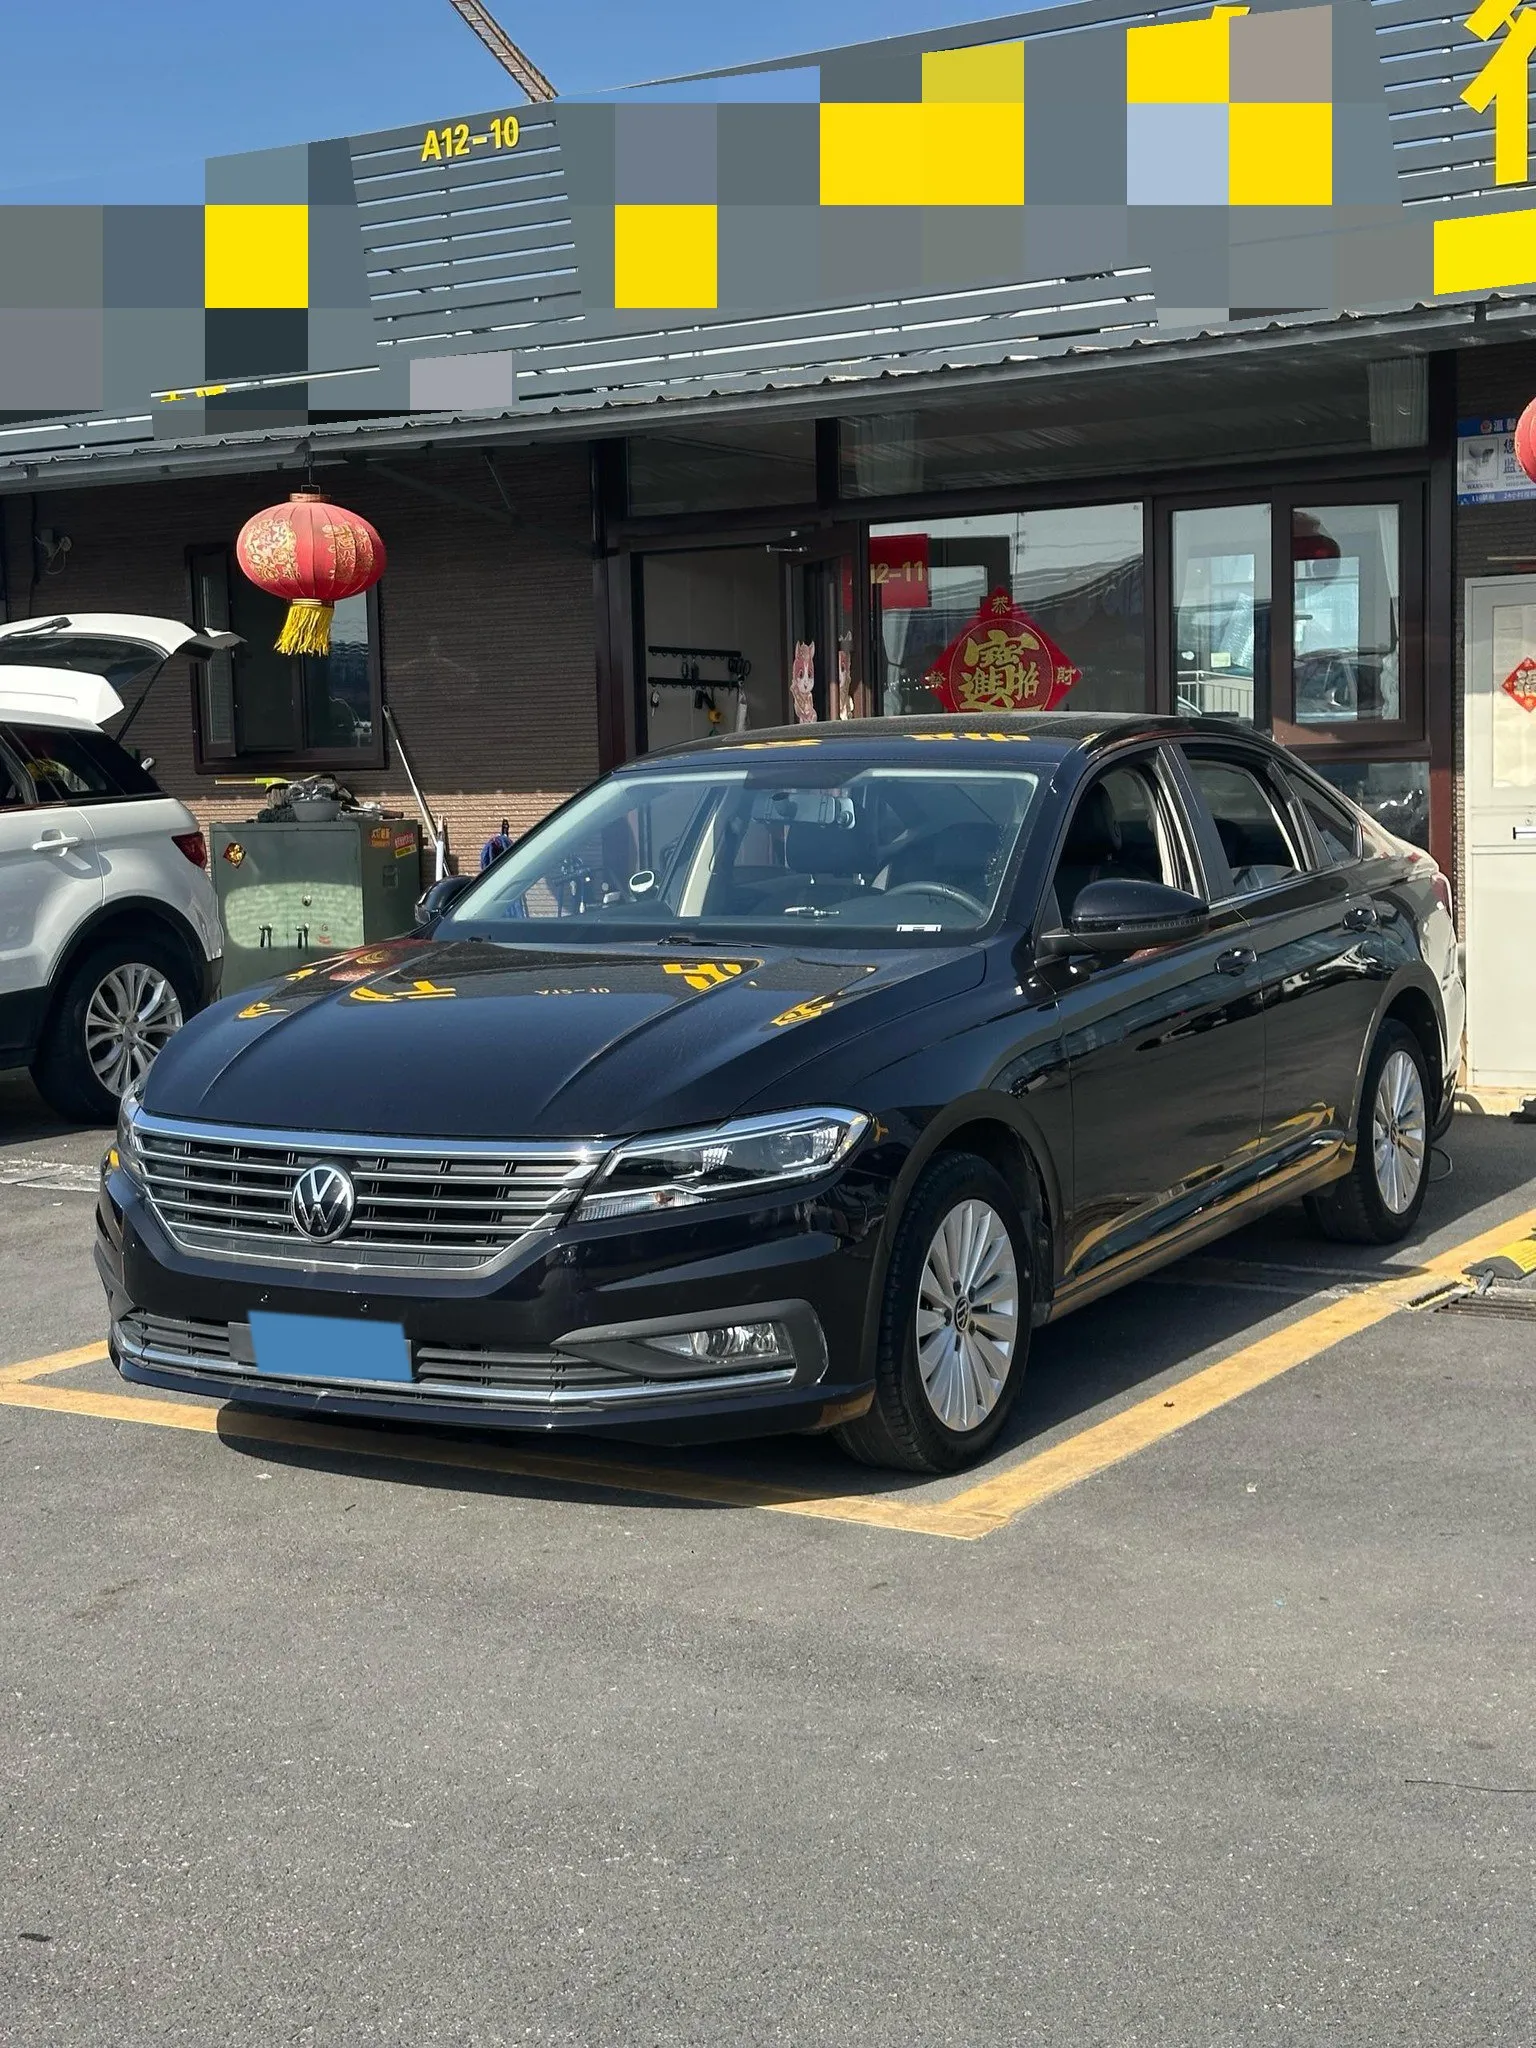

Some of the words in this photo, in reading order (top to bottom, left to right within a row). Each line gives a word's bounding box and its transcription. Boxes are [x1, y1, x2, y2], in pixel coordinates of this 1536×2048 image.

[421, 116, 519, 162] A12-10
[849, 560, 923, 586] 12-11
[991, 595, 1012, 615] 恭
